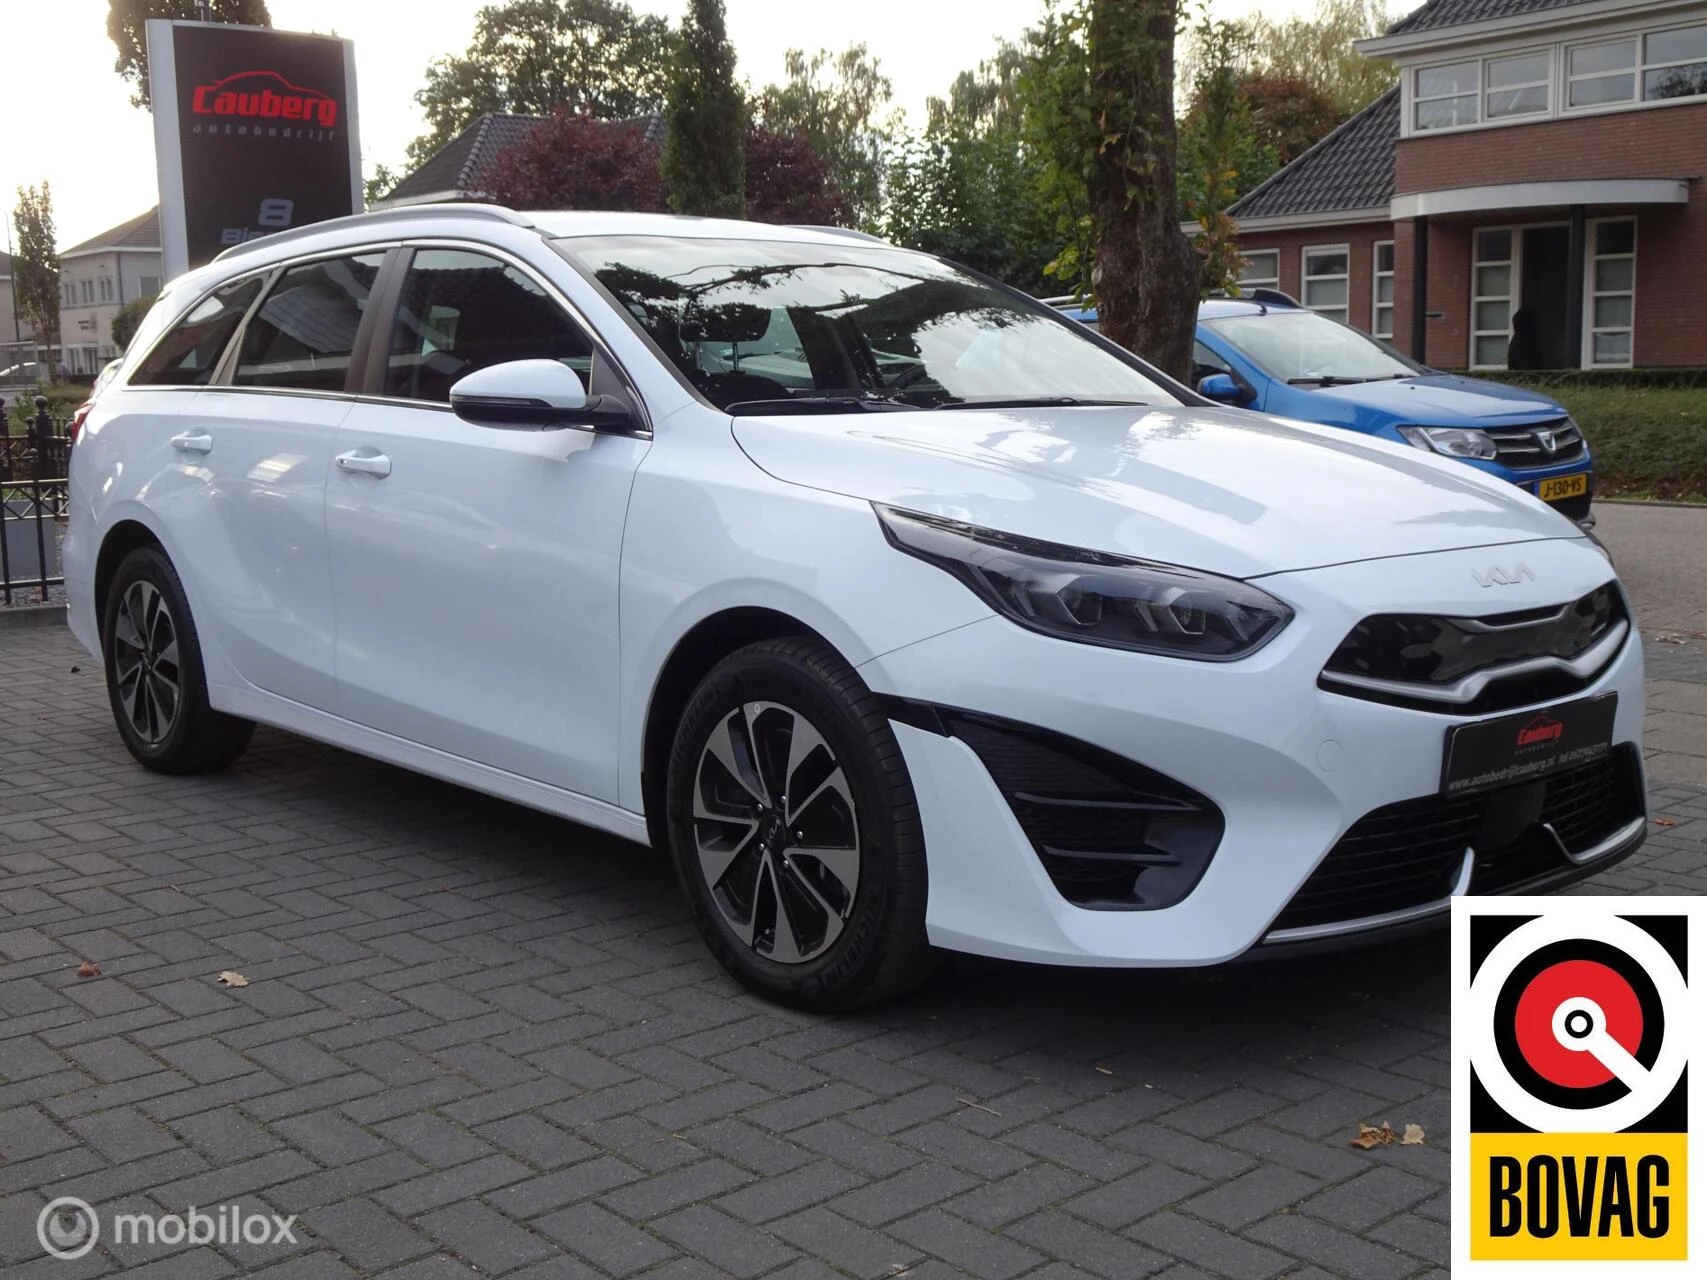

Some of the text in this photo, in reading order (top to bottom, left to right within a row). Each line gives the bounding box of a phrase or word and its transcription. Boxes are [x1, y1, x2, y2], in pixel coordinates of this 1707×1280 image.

[192, 84, 337, 128] Cauberg
[192, 122, 336, 141] autobedrijf
[1516, 722, 1564, 747] Cauberg
